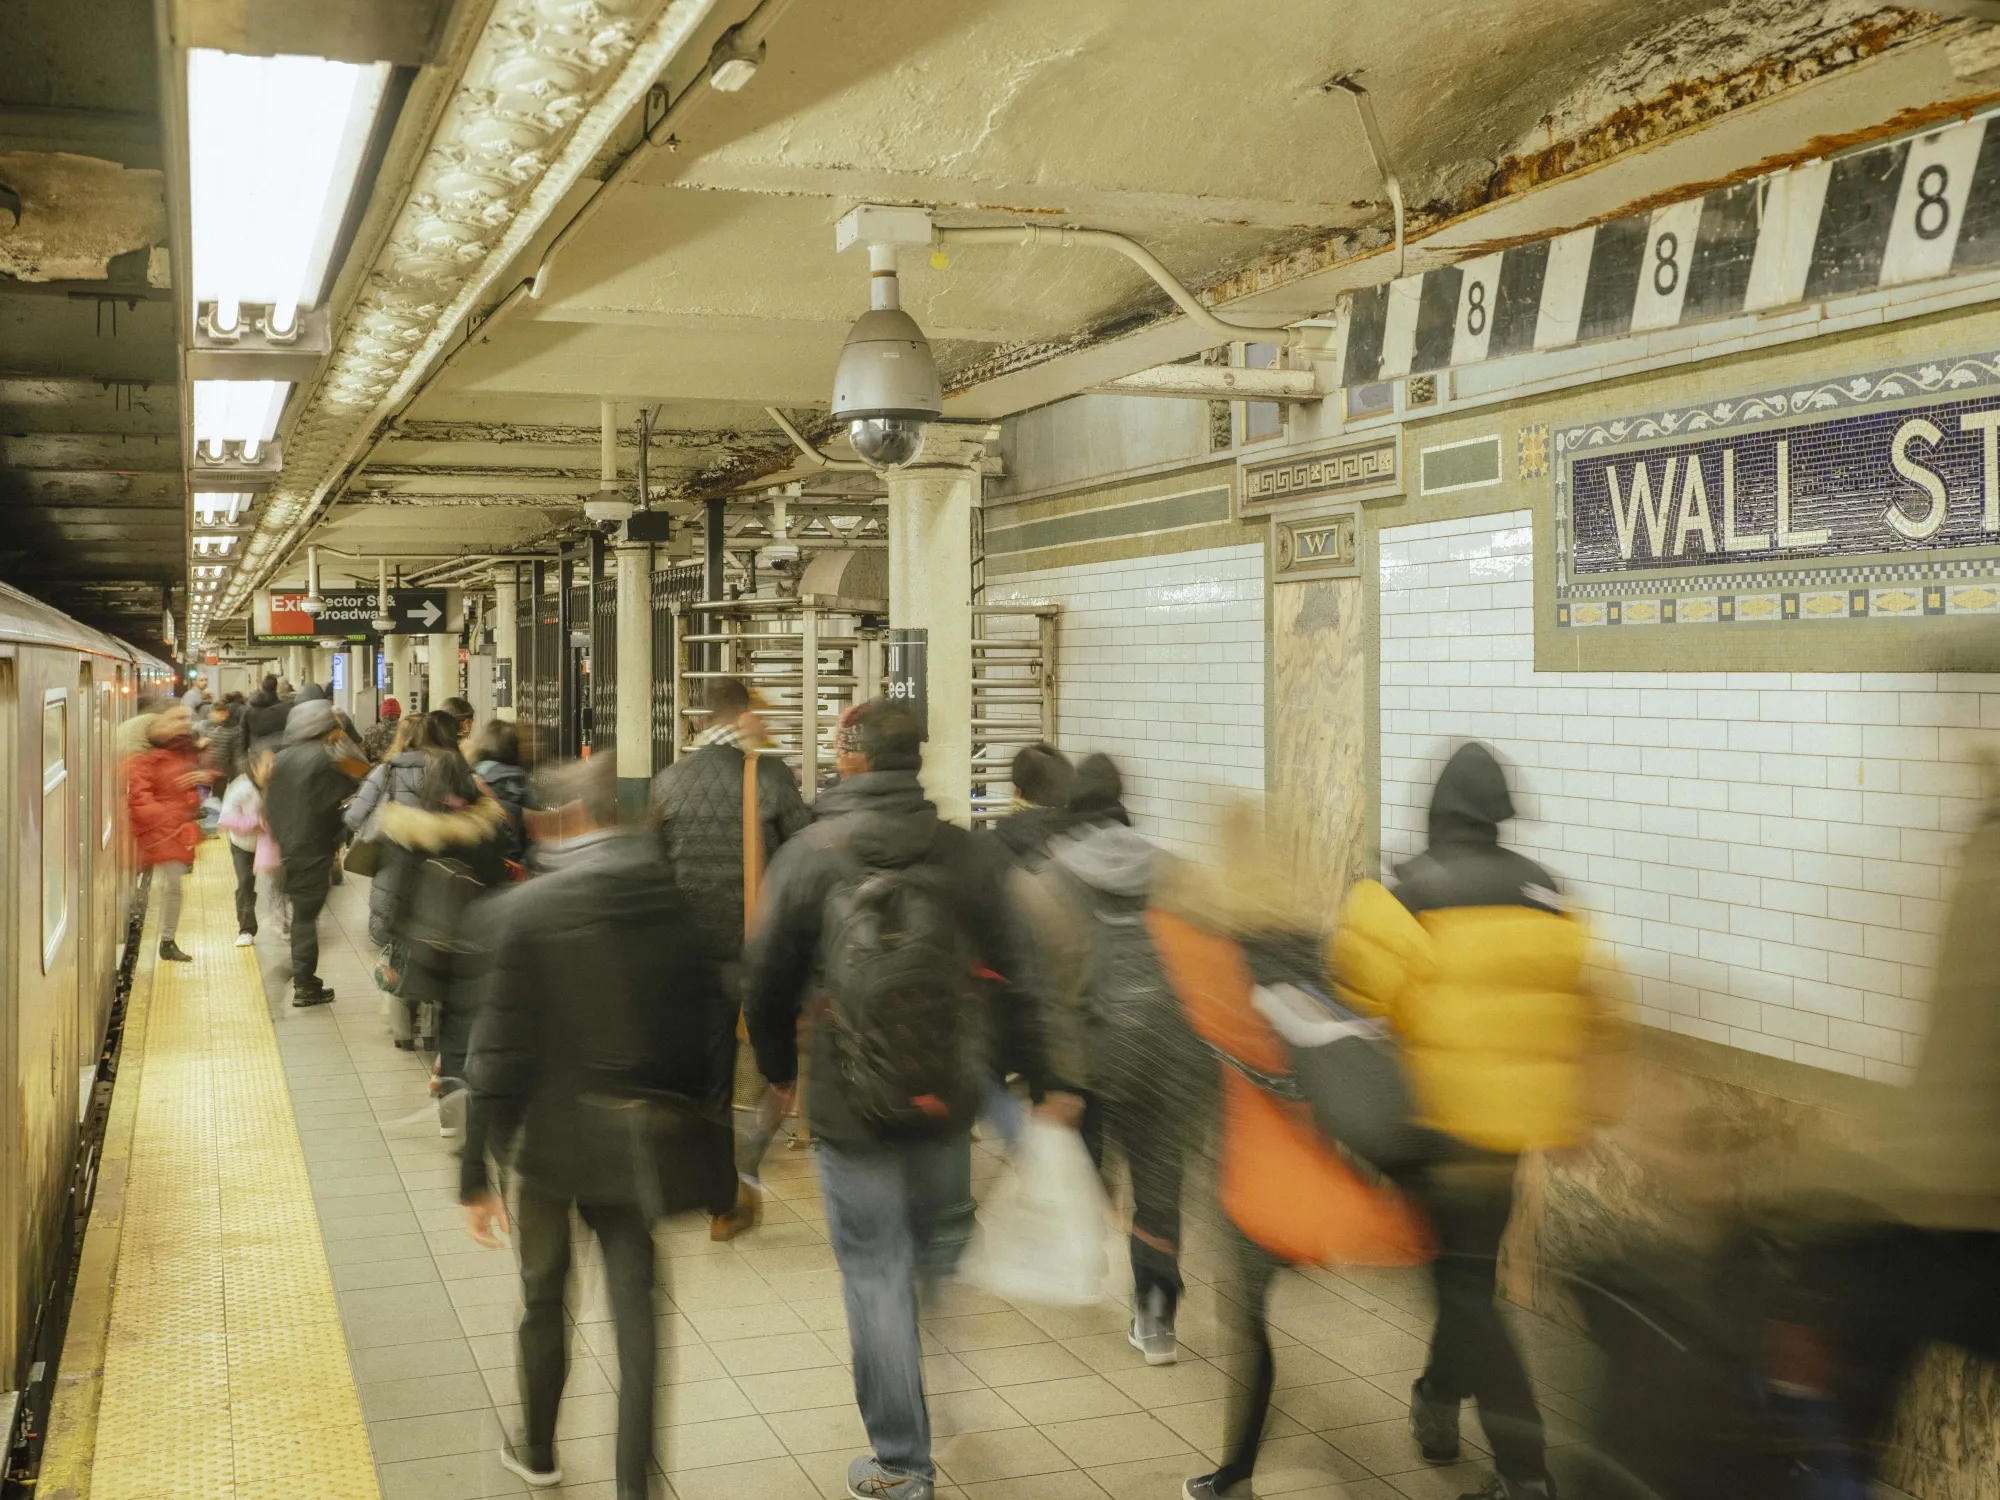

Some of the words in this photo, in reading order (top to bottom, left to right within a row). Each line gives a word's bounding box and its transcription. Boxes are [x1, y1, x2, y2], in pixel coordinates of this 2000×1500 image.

[1467, 280, 1486, 337] 8
[1653, 231, 1679, 296] 8
[1914, 163, 1950, 241] 8
[1606, 440, 1831, 560] WALL
[1303, 532, 1330, 555] W
[271, 595, 306, 612] Exi
[319, 595, 363, 607] ector
